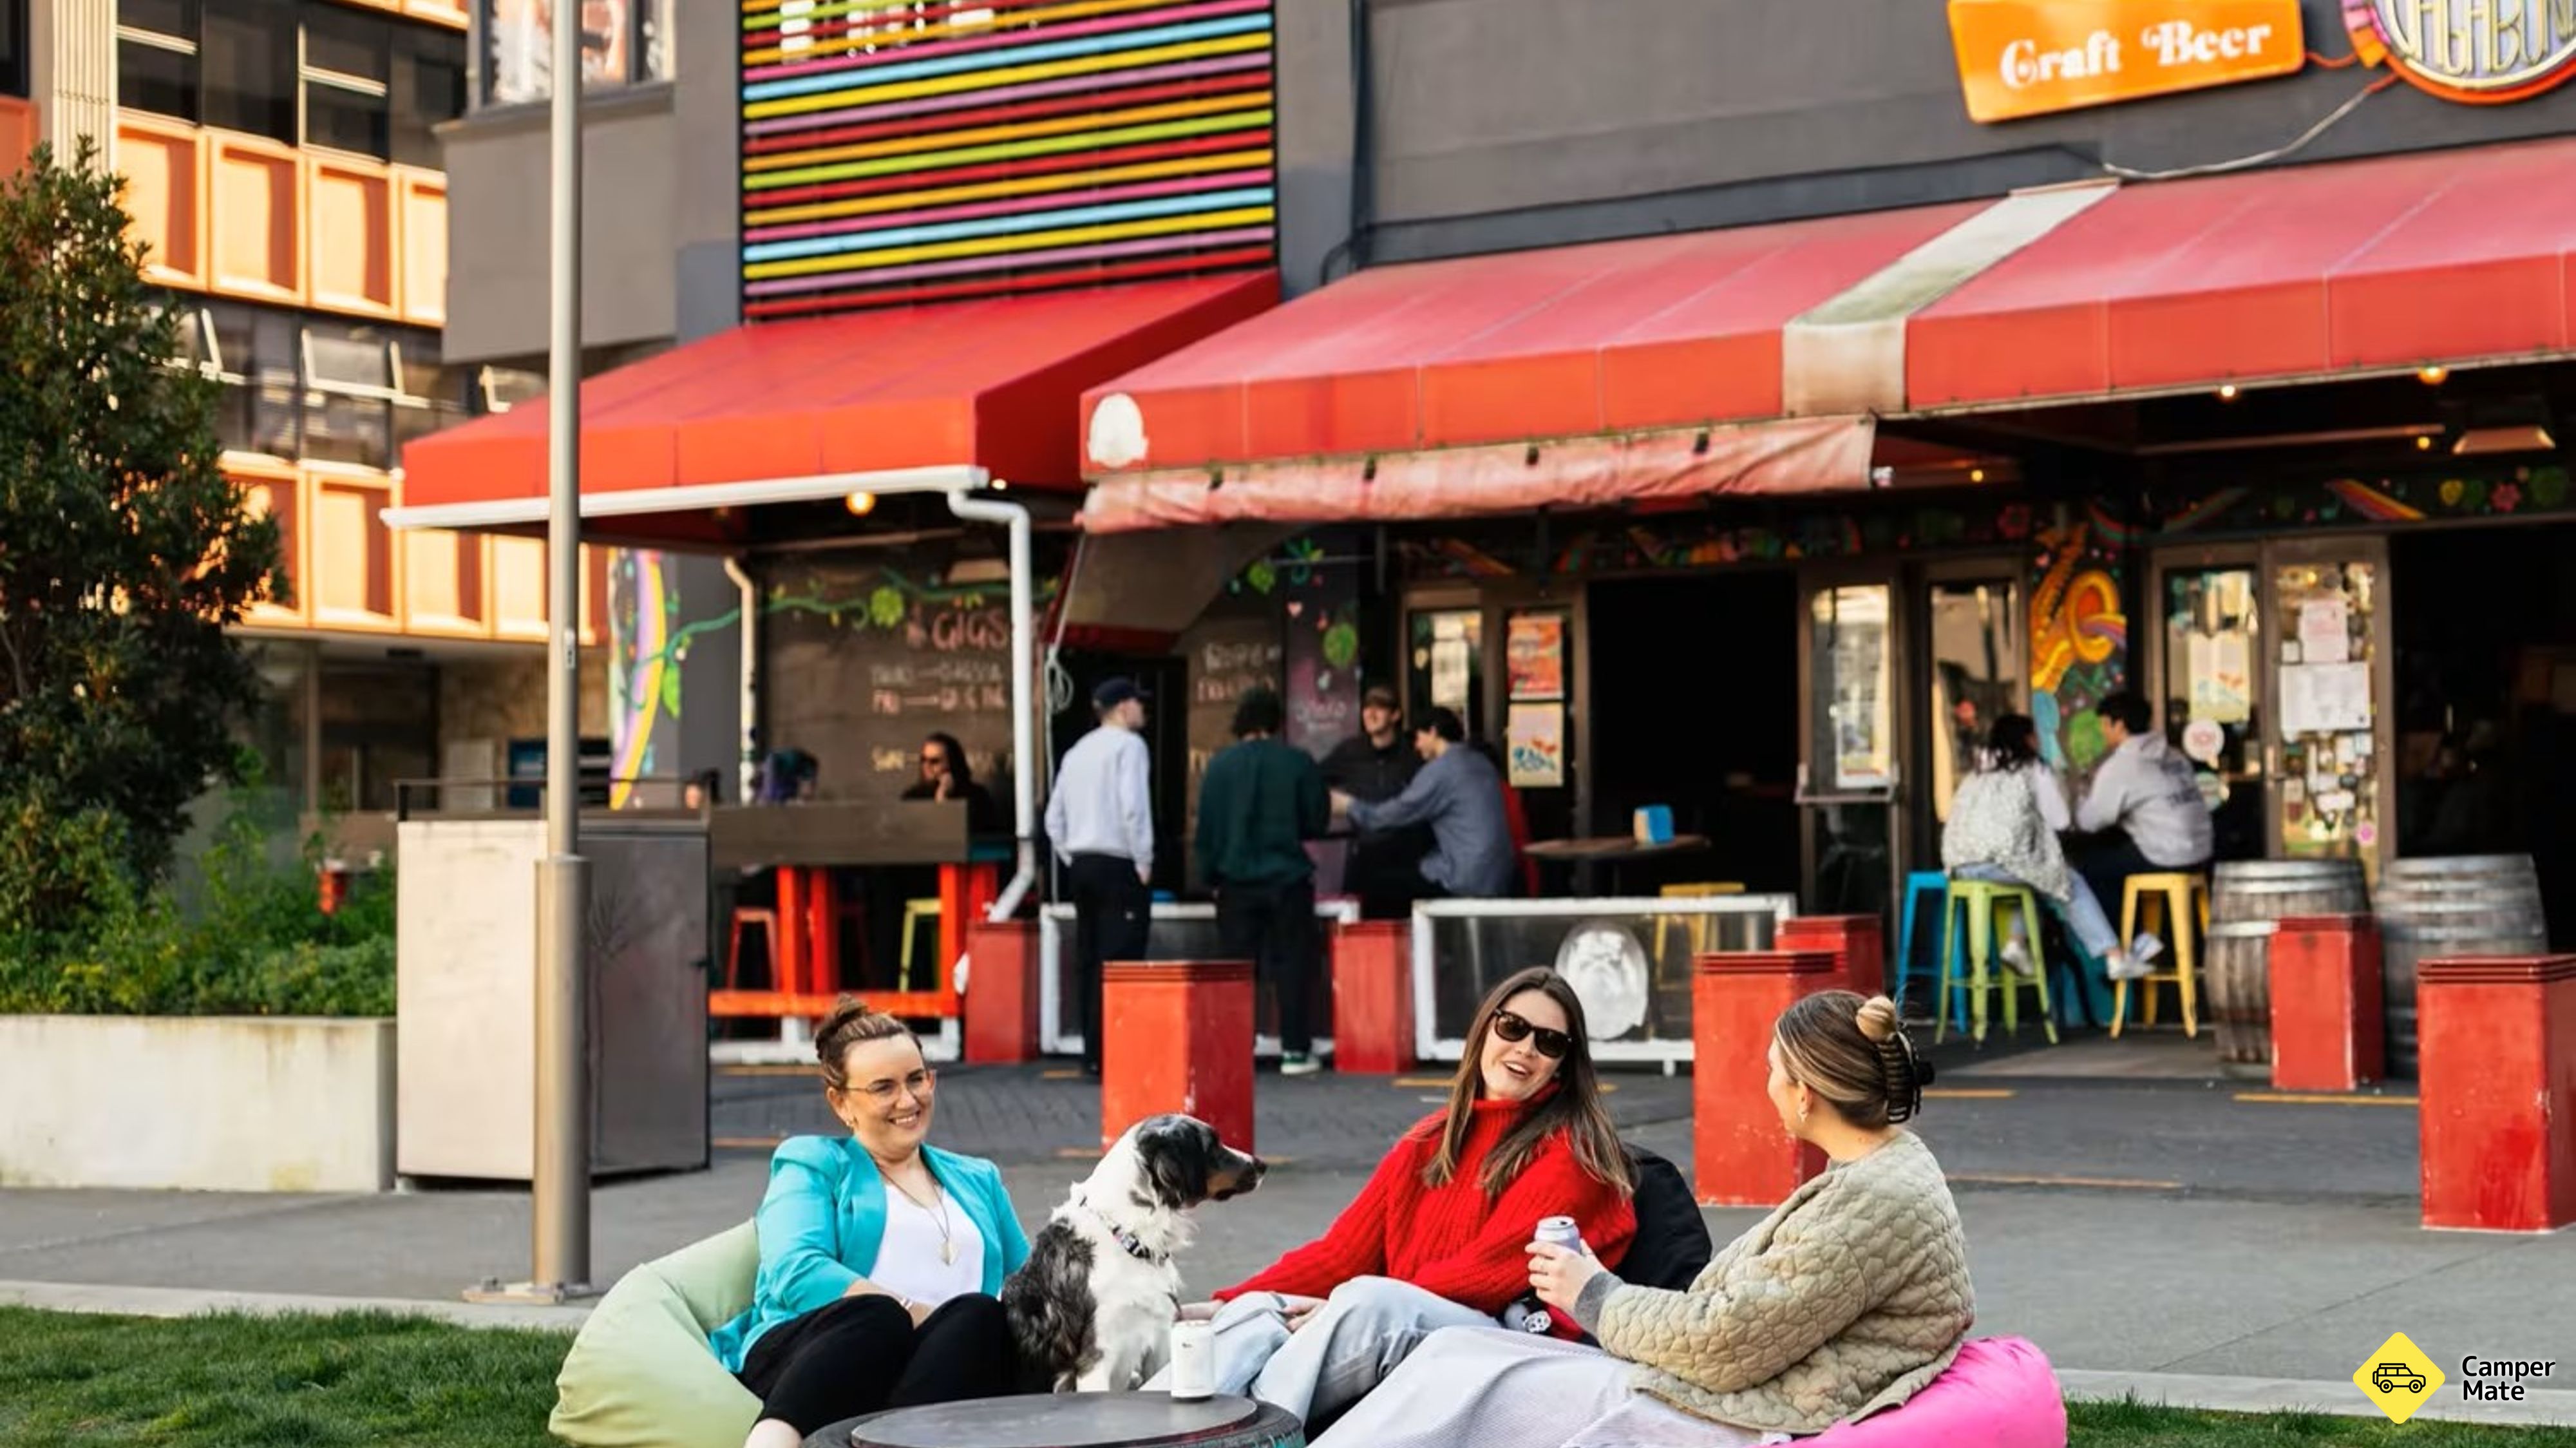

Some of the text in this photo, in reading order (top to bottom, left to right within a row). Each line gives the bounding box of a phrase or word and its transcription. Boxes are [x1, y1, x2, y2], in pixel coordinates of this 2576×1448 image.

[2000, 21, 2272, 89] Craft Beer
[932, 609, 1009, 650] GIGS
